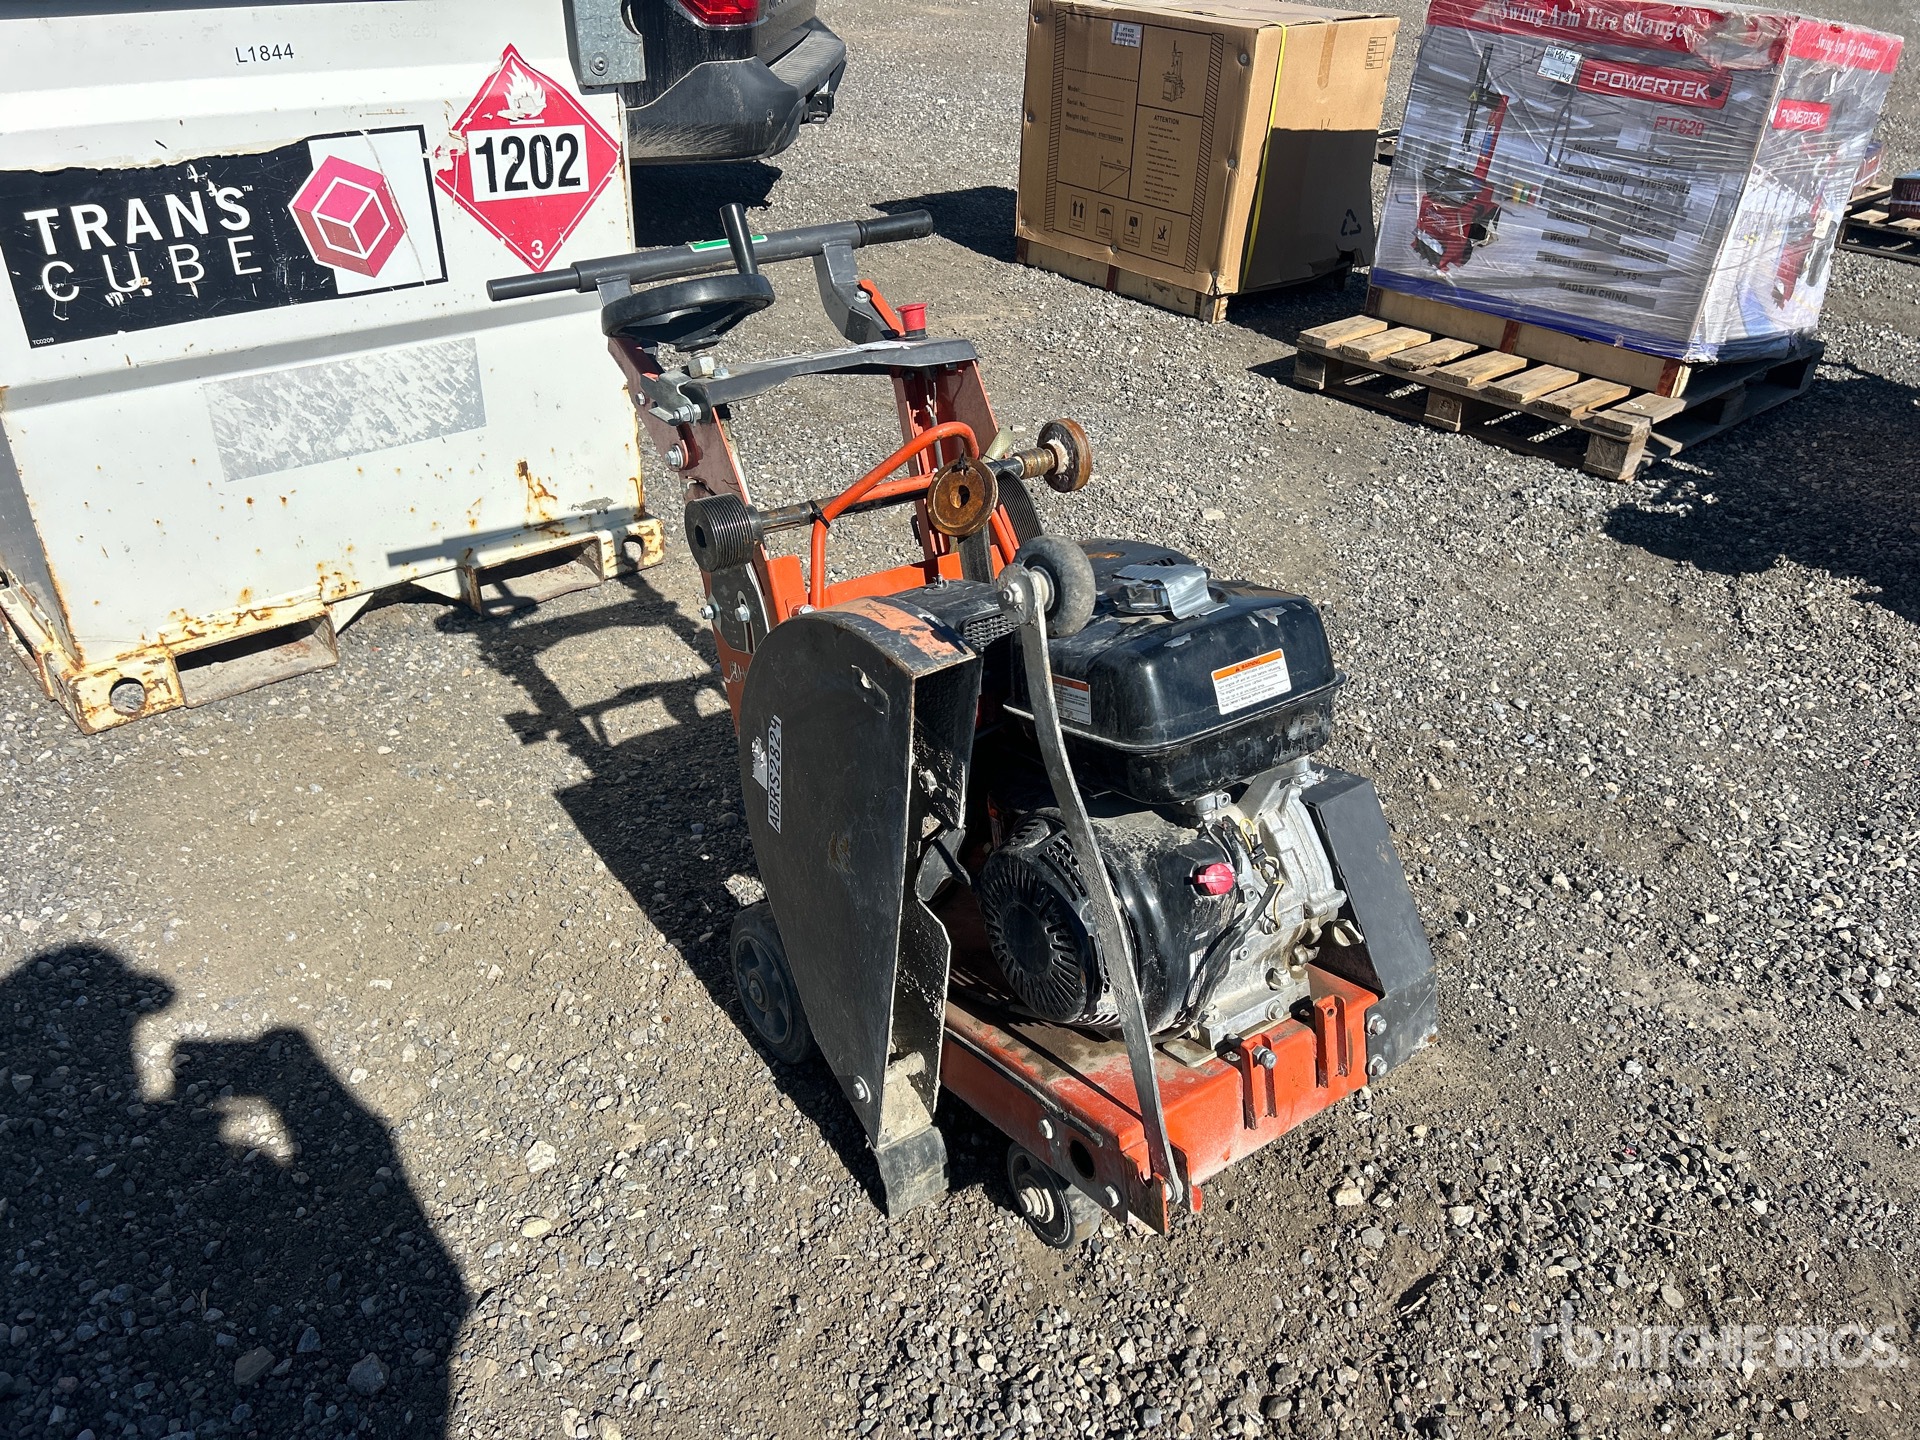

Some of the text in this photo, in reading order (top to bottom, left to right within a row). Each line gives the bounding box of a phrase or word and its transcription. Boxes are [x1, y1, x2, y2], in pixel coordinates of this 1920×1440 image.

[1500, 2, 1546, 27] Swing
[1550, 4, 1581, 27] Arm
[1585, 7, 1619, 31] Tire
[235, 43, 295, 64] L1844
[1592, 70, 1710, 100] POWERTEK
[1154, 115, 1180, 125] ATTENTION
[1653, 116, 1705, 136] PT620
[1780, 109, 1823, 126] POWERTEK
[1573, 143, 1600, 155] Motor
[474, 133, 582, 194] 1202
[1567, 166, 1628, 186] Power supply
[1562, 189, 1597, 202] Current
[531, 240, 544, 259] 3
[1550, 233, 1580, 246] Weight
[42, 235, 262, 302] CUBE
[1544, 254, 1598, 273] Wheel width
[1558, 282, 1629, 303] MADE IN CHINA
[769, 717, 781, 830] ABRS2824
